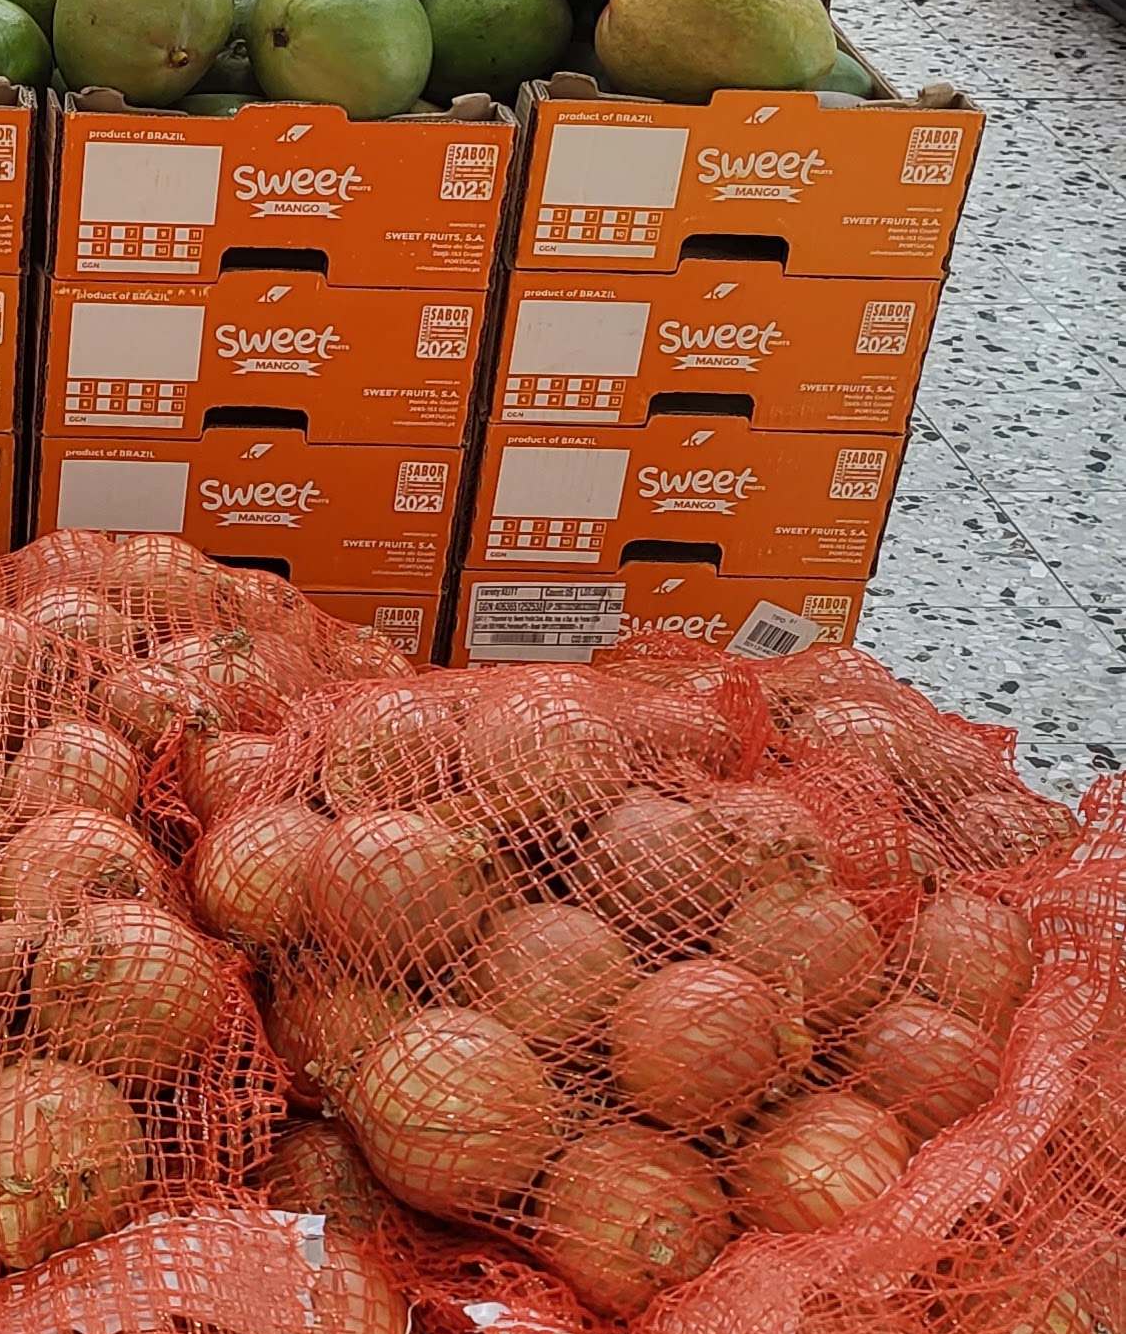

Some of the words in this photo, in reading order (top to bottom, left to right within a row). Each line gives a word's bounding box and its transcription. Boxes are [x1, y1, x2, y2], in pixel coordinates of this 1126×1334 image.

[558, 112, 601, 124] product
[603, 113, 614, 122] of
[616, 114, 654, 124] BRAZIL
[89, 130, 132, 142] product
[134, 130, 146, 140] of
[147, 131, 186, 141] BRAZIL
[919, 130, 959, 145] SABOR
[454, 147, 495, 161] SABOR
[697, 148, 825, 184] Sweet
[903, 165, 951, 183] 2023
[233, 166, 362, 201] Sweet
[441, 181, 492, 199] 2023
[735, 187, 780, 197] MANGO
[274, 203, 320, 213] MANGO
[842, 216, 877, 226] SWEET
[921, 218, 941, 227] S.A.
[385, 232, 420, 241] SWEET
[465, 234, 485, 242] S.A.
[77, 291, 116, 303] product
[118, 291, 130, 301] of
[133, 292, 170, 302] BRAZIL
[524, 288, 564, 300] product
[566, 289, 578, 298] of
[579, 290, 617, 299] BRAZIL
[429, 307, 470, 322] SABOR
[872, 303, 911, 318] SABOR
[215, 325, 341, 359] Sweet
[658, 321, 781, 355] Sweet
[858, 336, 906, 353] 2023
[417, 340, 467, 358] 2023
[255, 361, 300, 371] MANGO
[695, 357, 740, 367] MANGO
[363, 389, 397, 398] SWEET
[441, 390, 460, 399] S.A.
[800, 384, 834, 393] SWEET
[876, 385, 896, 394] S.A.
[507, 436, 548, 447] product
[549, 436, 560, 445] of
[561, 436, 597, 446] BRAZIL
[65, 449, 105, 460] product
[107, 449, 118, 458] of
[119, 450, 155, 459] BRAZIL
[845, 451, 883, 466] SABOR
[407, 464, 445, 478] SABOR
[638, 467, 757, 499] Sweet
[200, 480, 321, 512] Sweet
[830, 482, 879, 499] 2023
[395, 495, 443, 512] 2023
[674, 500, 716, 510] MANGO
[238, 513, 281, 523] MANGO
[775, 527, 808, 536] SWEET
[342, 540, 376, 549] SWEET
[811, 597, 849, 610] SABOR
[383, 609, 420, 621] SABOR
[820, 626, 844, 642] 23
[393, 638, 417, 654] 23
